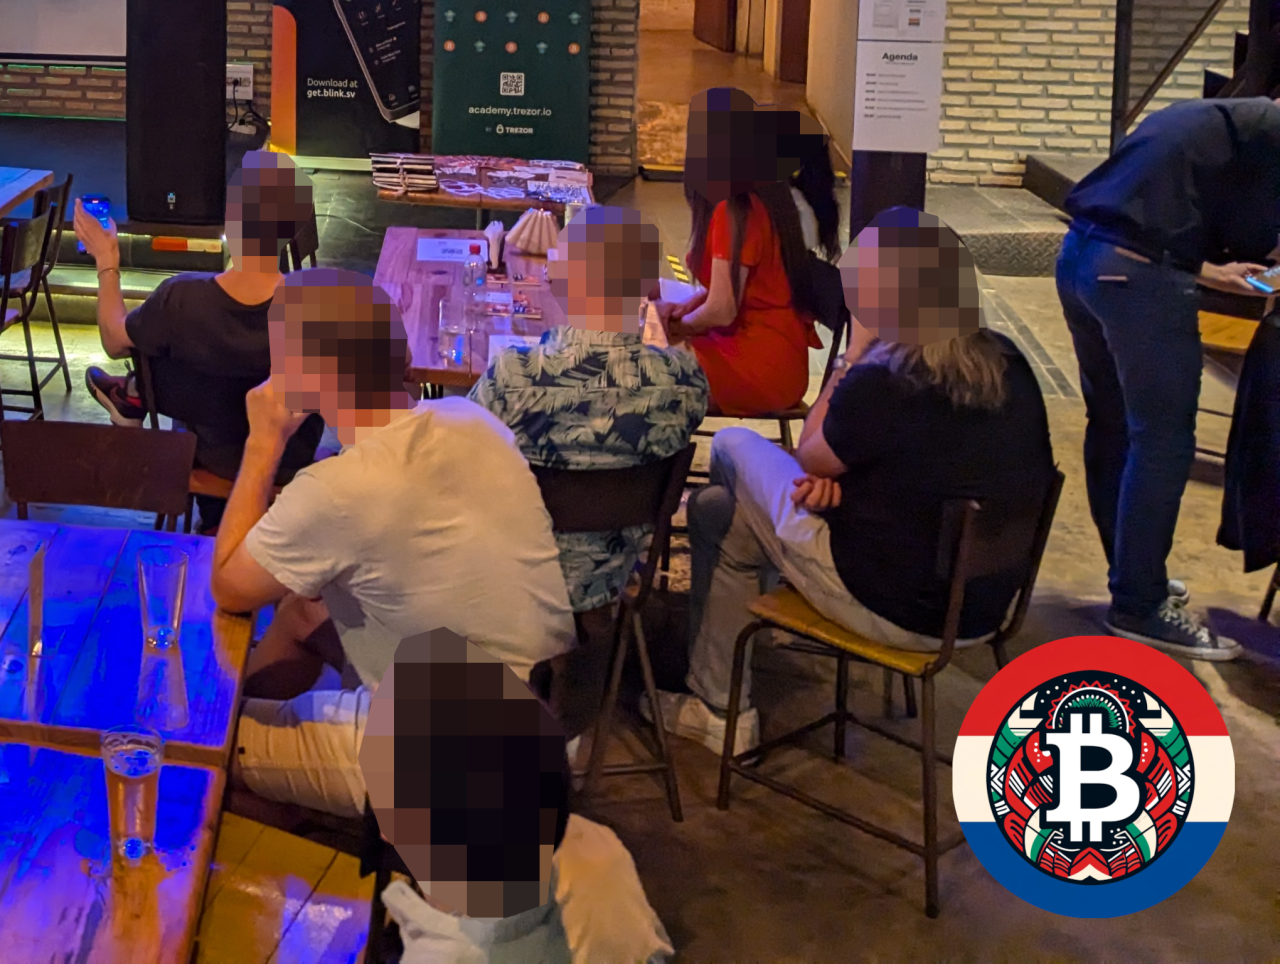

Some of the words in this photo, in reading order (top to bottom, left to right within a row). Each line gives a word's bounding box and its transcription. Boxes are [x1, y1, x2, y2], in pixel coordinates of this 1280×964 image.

[882, 52, 918, 62] Agenda
[307, 78, 347, 88] Download
[349, 79, 358, 88] at
[306, 88, 356, 99] get.blink.sv
[468, 106, 552, 117] academy.trezor.io
[505, 126, 534, 134] TREZOR
